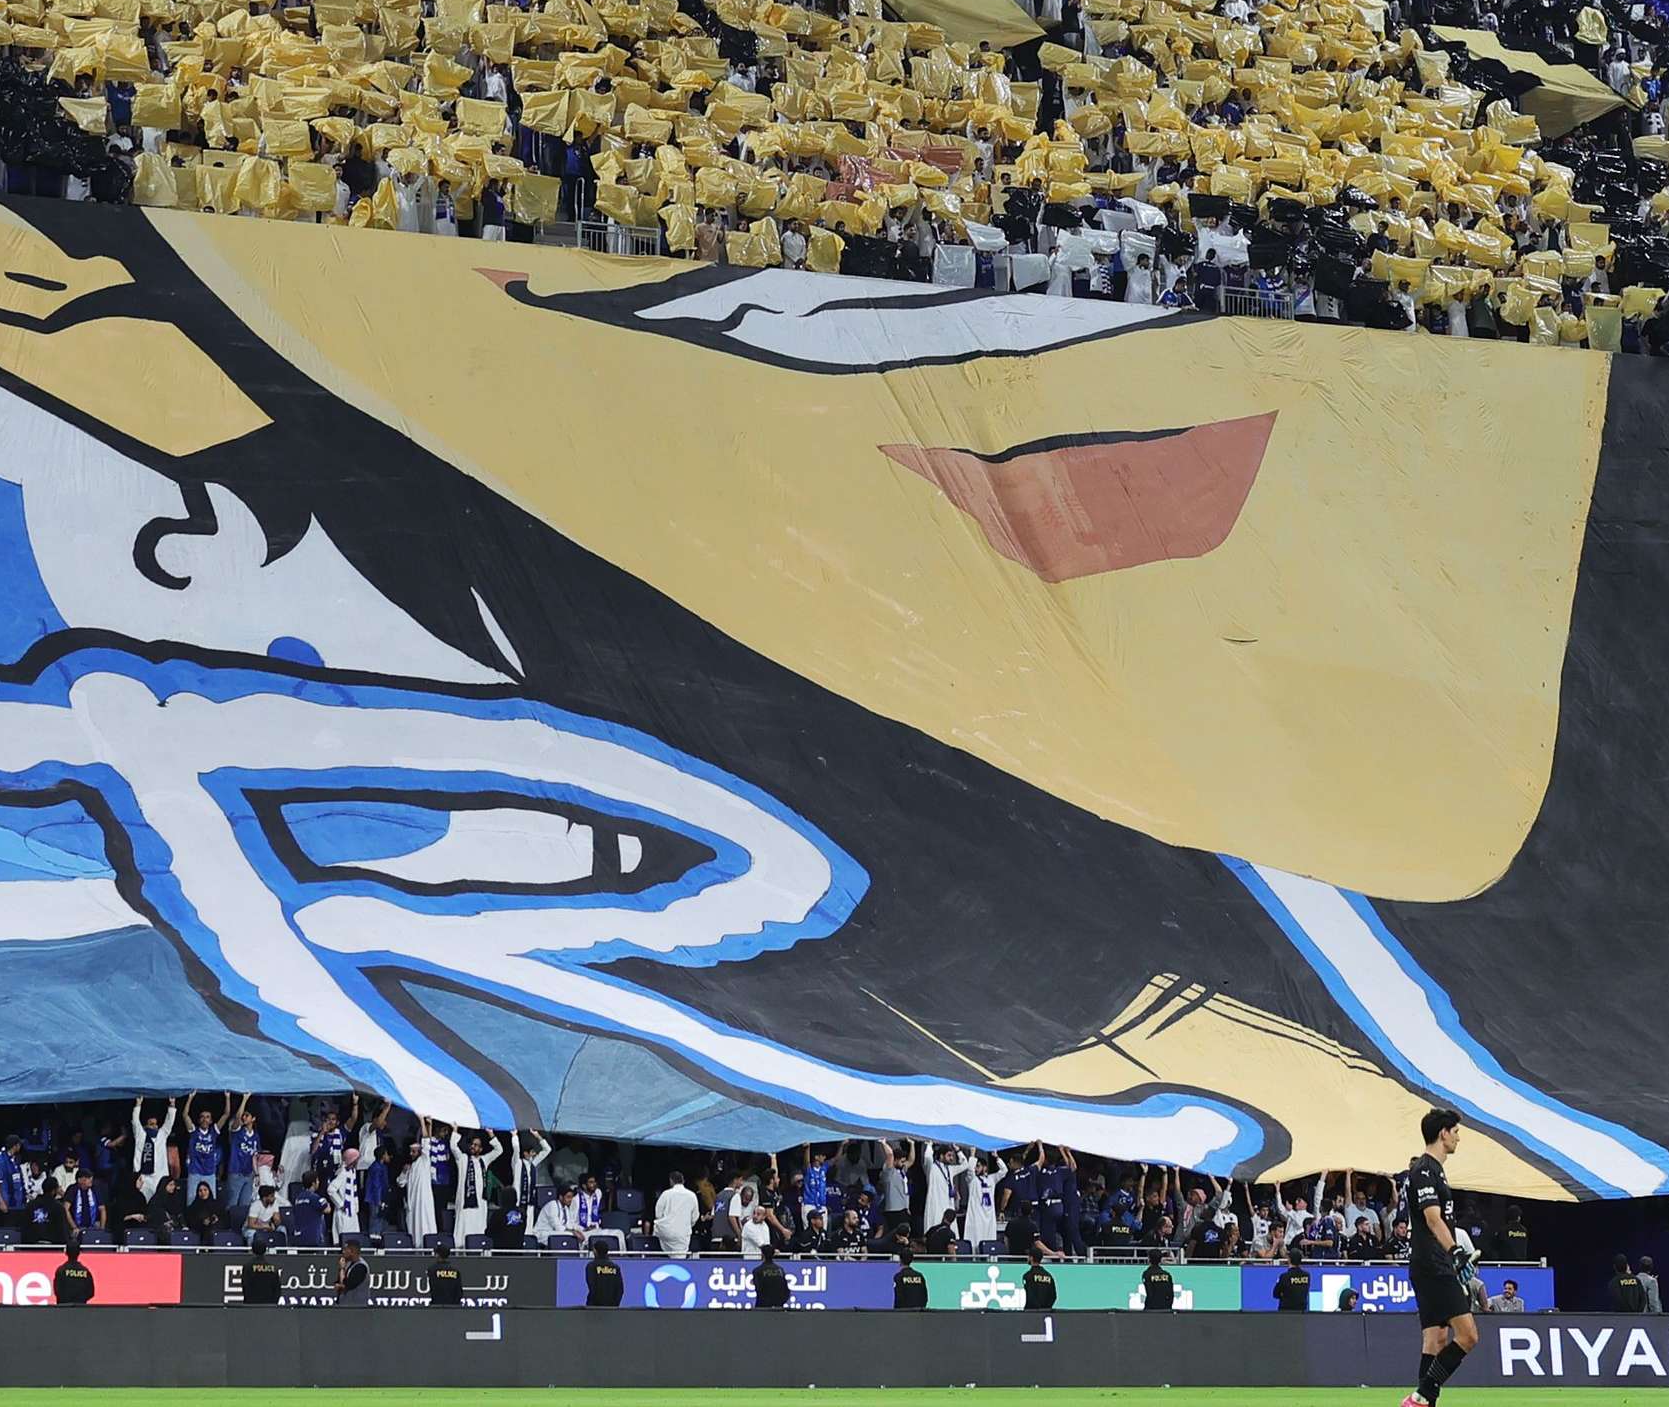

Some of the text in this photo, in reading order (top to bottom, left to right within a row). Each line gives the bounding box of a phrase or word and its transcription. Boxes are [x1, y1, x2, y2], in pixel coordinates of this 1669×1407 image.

[1111, 1225, 1130, 1235] POLICE
[252, 1264, 276, 1273] POLICE
[596, 1265, 617, 1276] Police
[65, 1268, 88, 1280] POLICE
[436, 1270, 458, 1279] POLICE
[1150, 1274, 1169, 1283] POLICE
[902, 1276, 922, 1285] POLICE
[1033, 1274, 1052, 1284] POLICE
[1290, 1276, 1309, 1285] POLICE
[1620, 1277, 1638, 1286] POLICE
